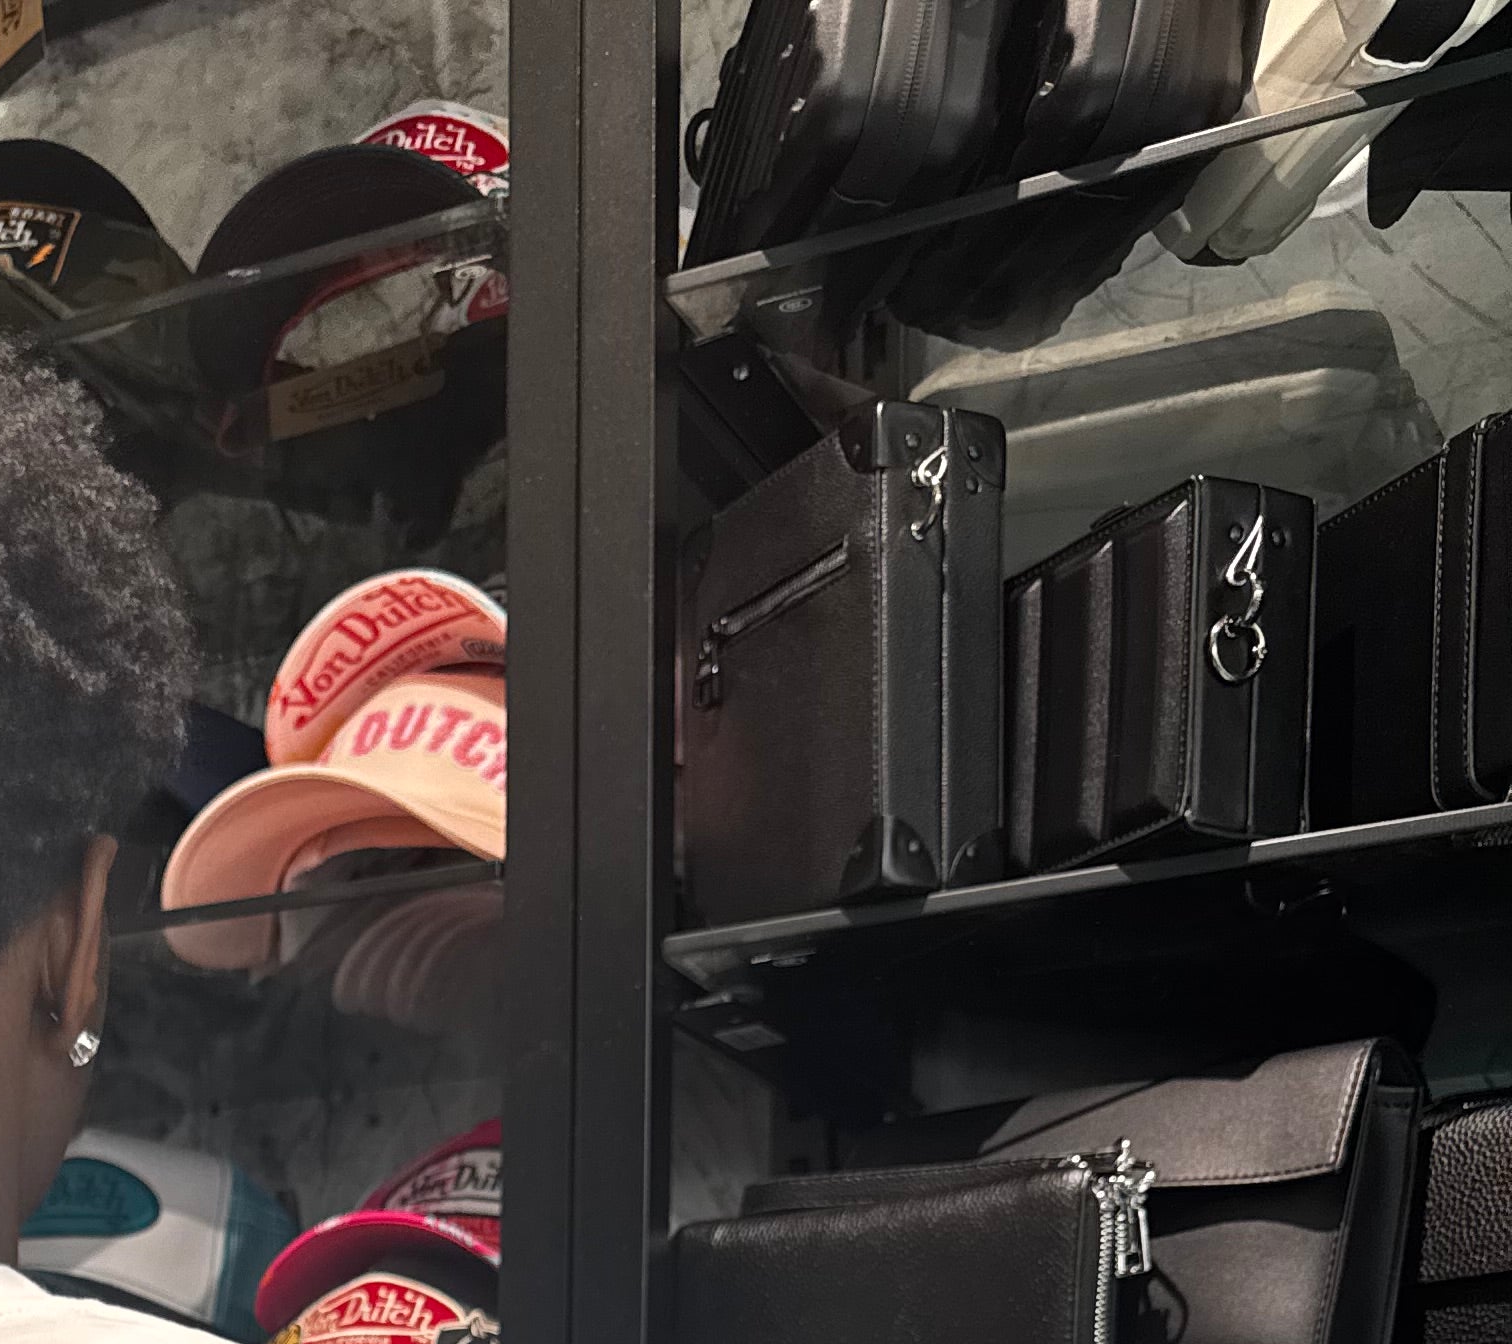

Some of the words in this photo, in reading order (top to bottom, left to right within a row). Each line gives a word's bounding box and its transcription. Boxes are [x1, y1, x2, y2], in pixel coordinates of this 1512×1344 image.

[372, 122, 478, 161] Dutch
[279, 649, 363, 718] Von
[336, 577, 474, 646] Dutch
[334, 1286, 434, 1333] Dutch
